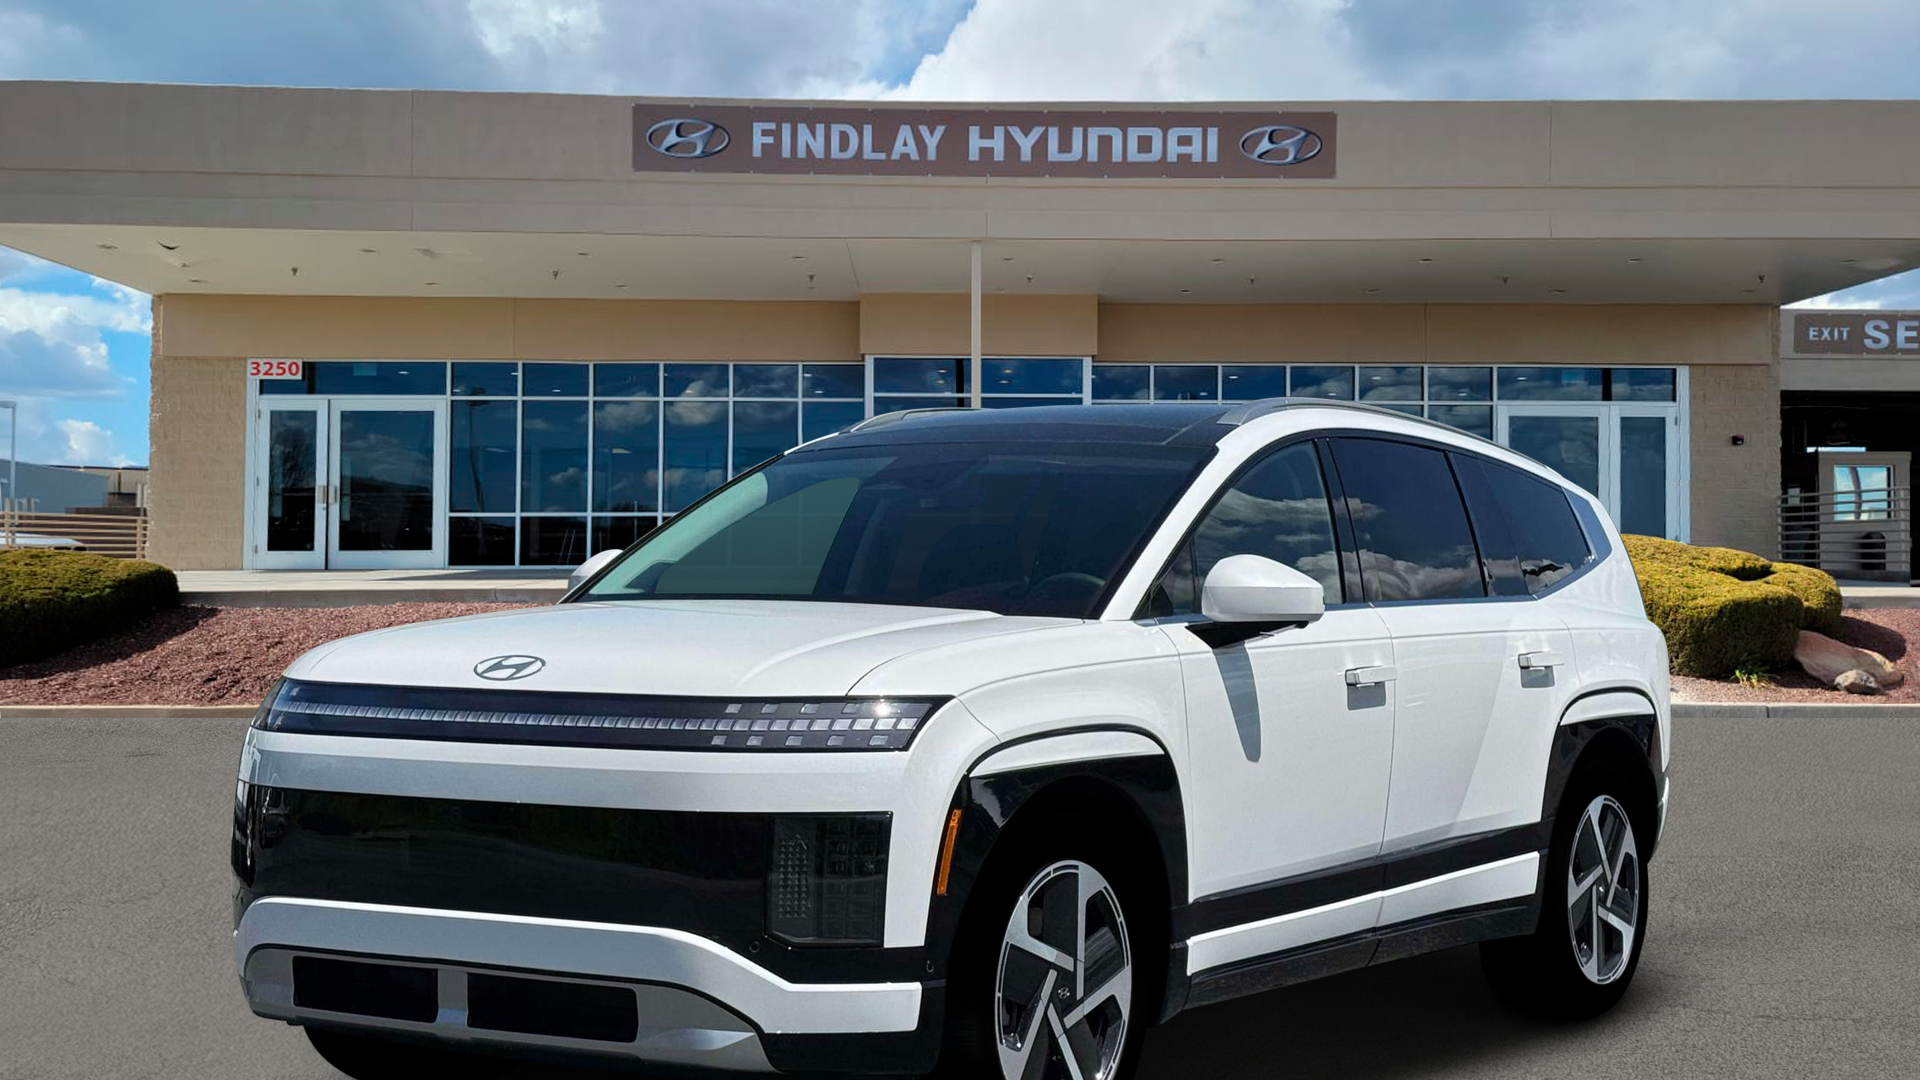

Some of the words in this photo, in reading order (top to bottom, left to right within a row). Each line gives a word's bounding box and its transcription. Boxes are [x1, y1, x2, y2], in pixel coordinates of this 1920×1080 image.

[751, 121, 947, 162] FINDLAY
[967, 126, 1219, 163] HYUNDAI
[1808, 326, 1850, 341] EXIT
[1863, 319, 1920, 350] SE
[249, 361, 300, 376] 3250
